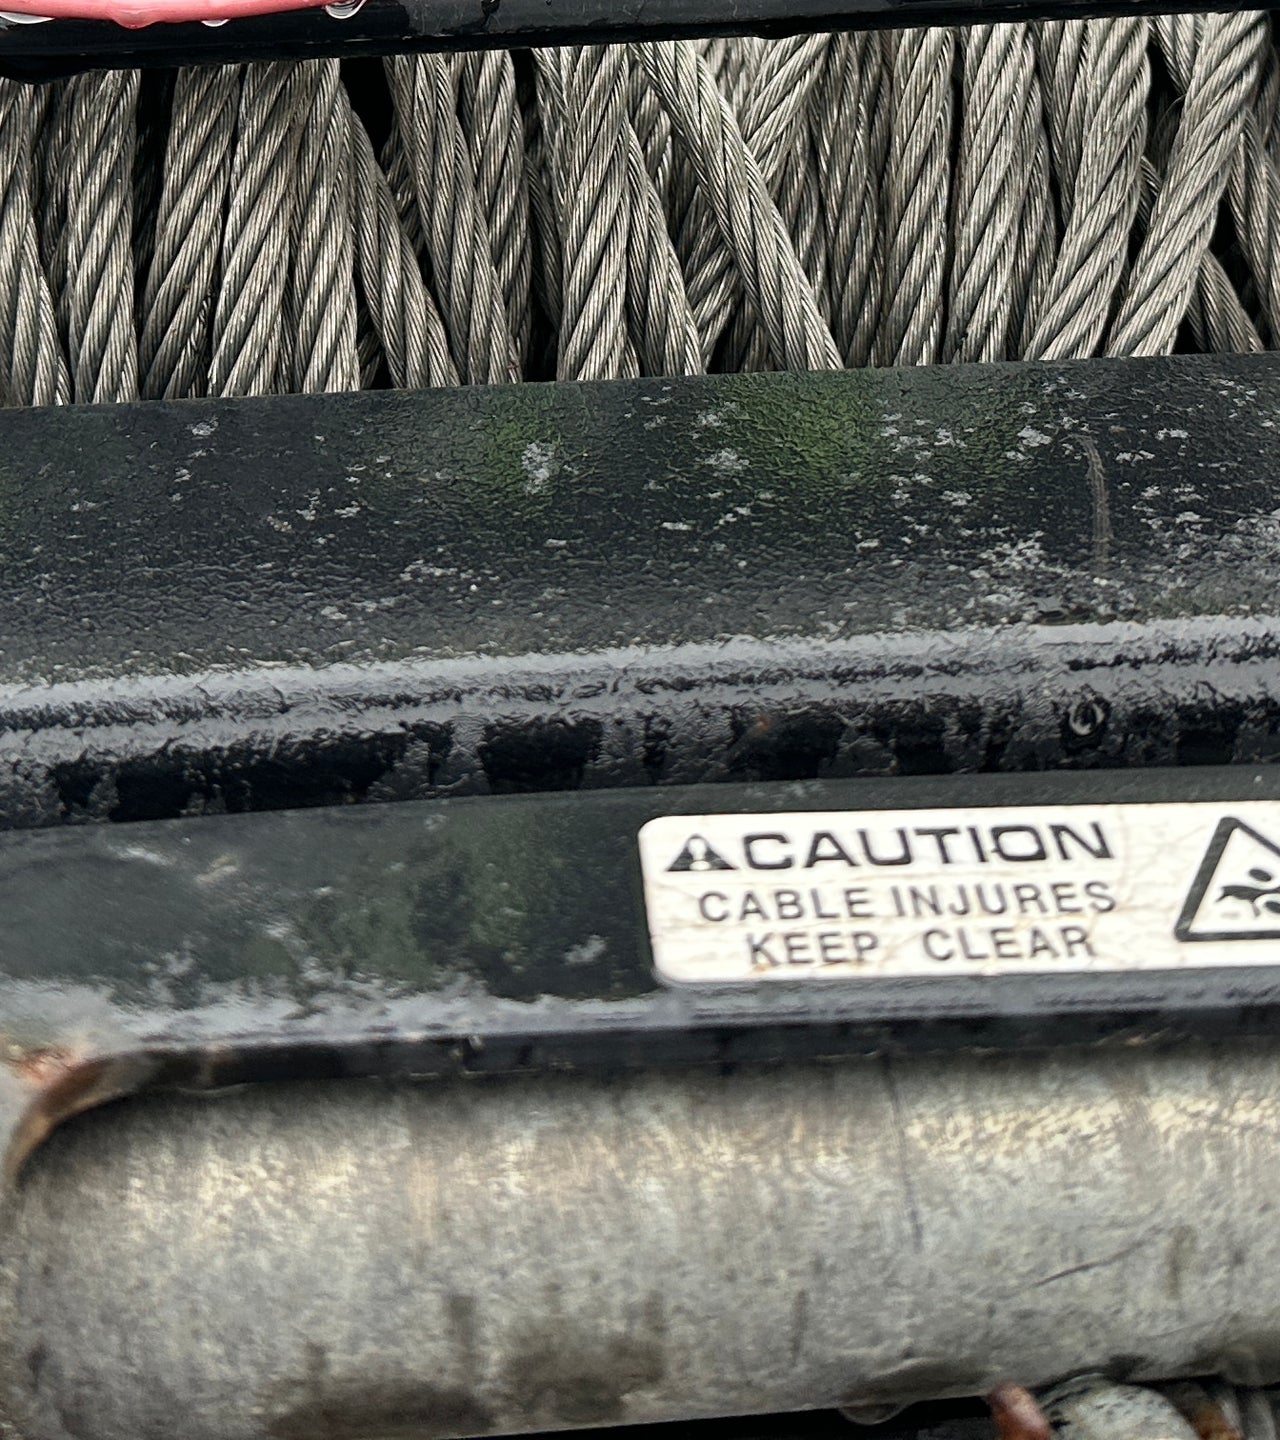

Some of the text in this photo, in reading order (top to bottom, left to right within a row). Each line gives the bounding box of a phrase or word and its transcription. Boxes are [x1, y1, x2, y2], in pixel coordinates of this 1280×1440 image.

[742, 822, 1114, 871] CAUTION
[698, 880, 1118, 923] CABLE INJURES
[746, 924, 1096, 966] KEEP CLEAR
